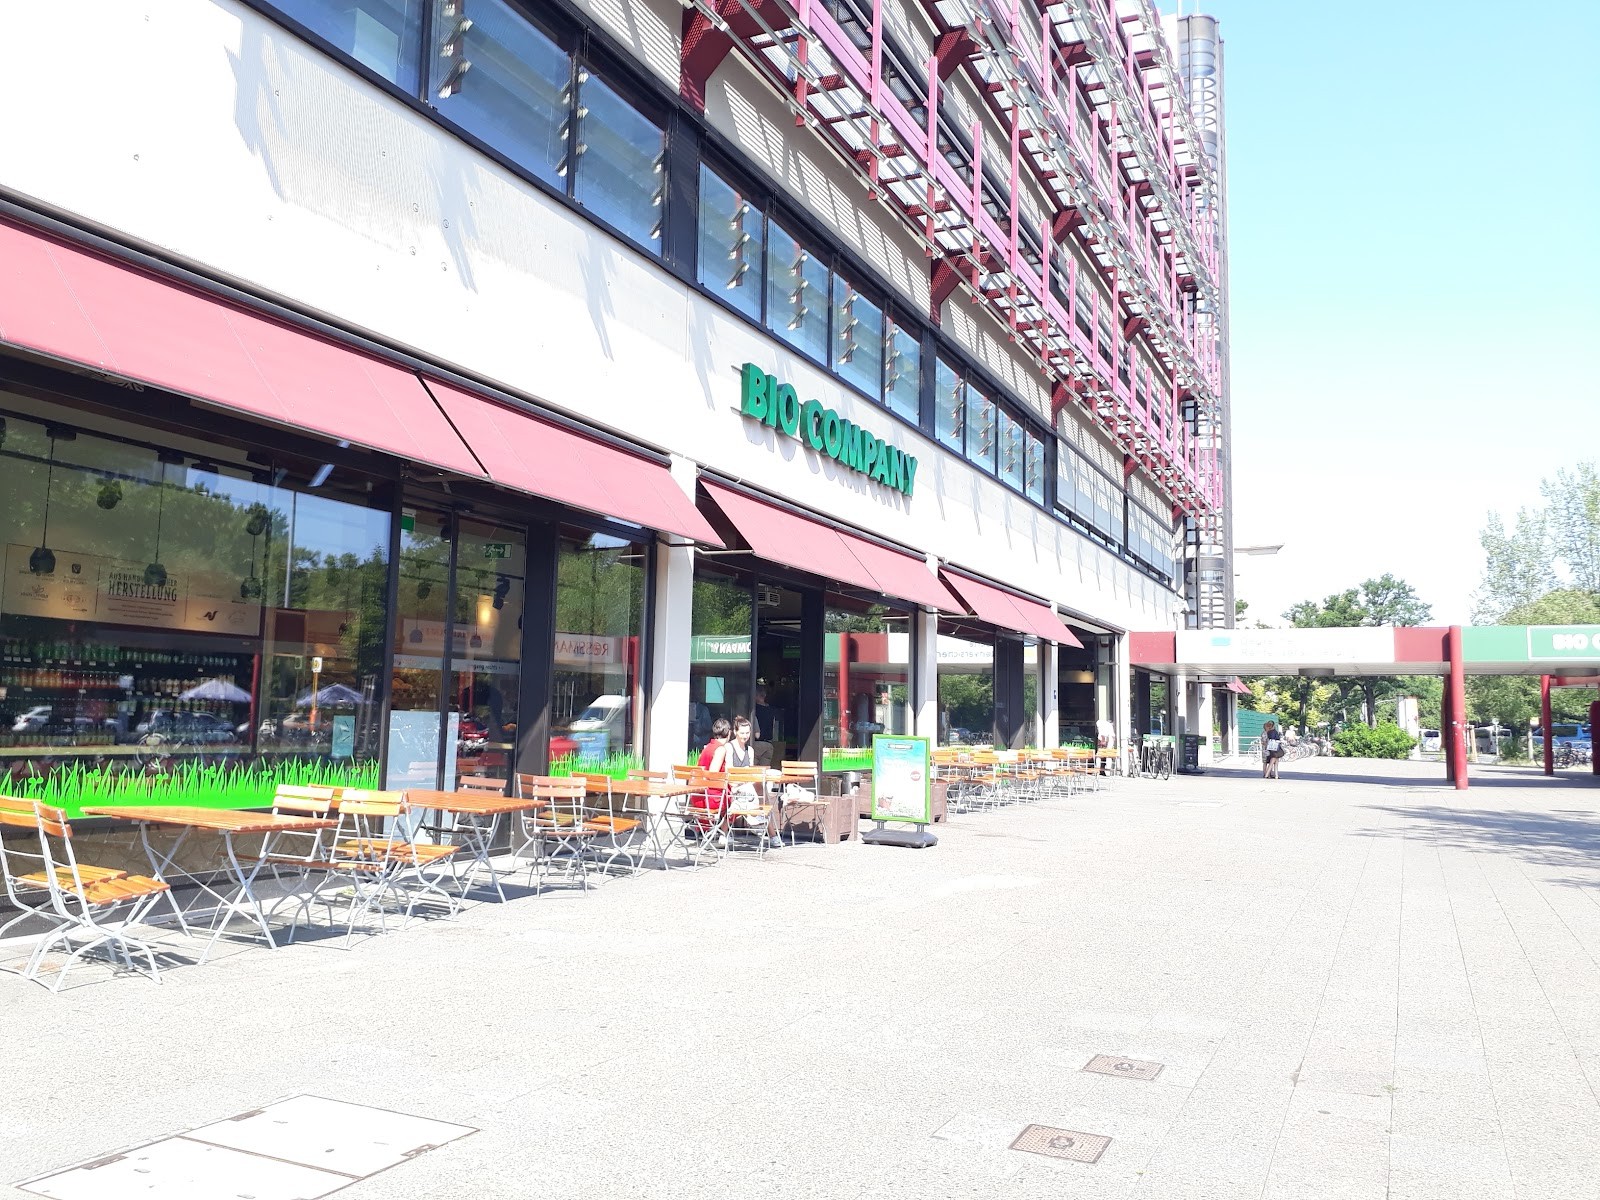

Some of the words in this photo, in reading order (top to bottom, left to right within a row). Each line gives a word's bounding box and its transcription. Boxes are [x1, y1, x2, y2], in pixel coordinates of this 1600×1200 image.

[741, 362, 799, 435] BIO
[800, 399, 918, 496] COMPANY
[108, 580, 177, 602] HERSTELLUNG
[1552, 633, 1588, 650] BIO
